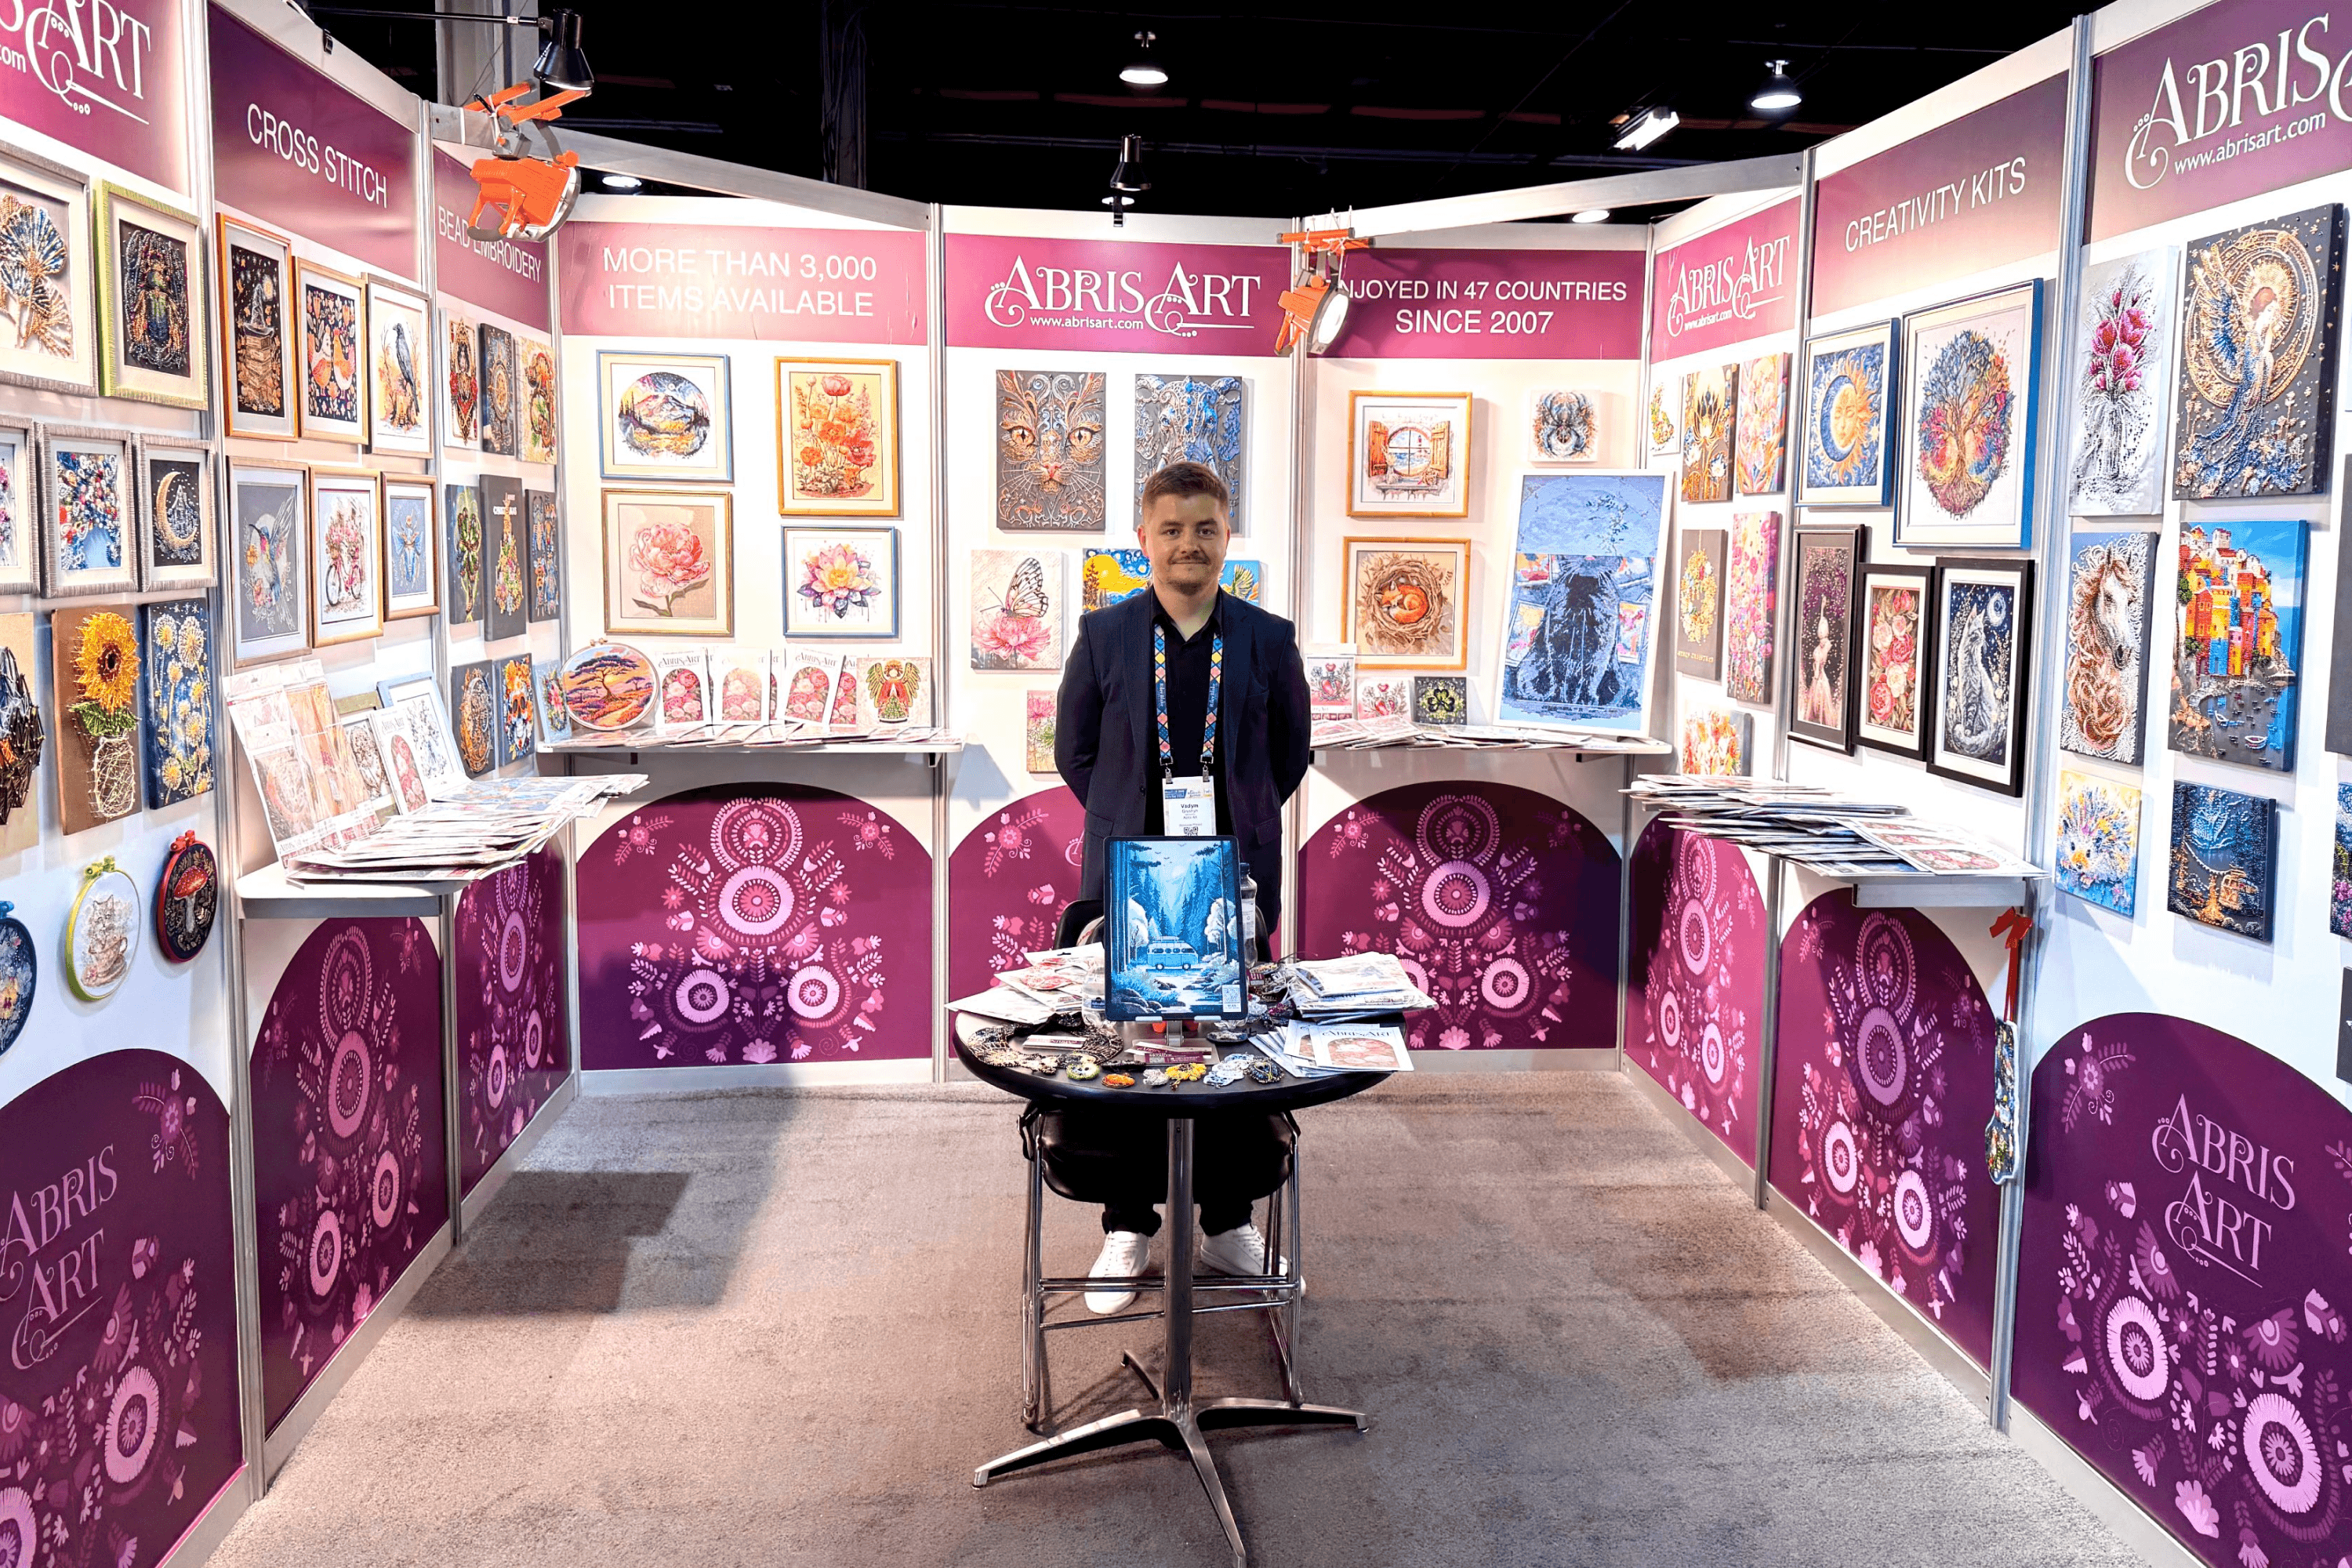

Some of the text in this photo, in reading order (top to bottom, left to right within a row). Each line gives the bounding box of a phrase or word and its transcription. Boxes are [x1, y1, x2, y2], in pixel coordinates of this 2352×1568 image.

[2125, 13, 2330, 189] ABRIS
[2175, 112, 2326, 174] www.abrisart.com
[248, 103, 387, 209] CROSS STITCH
[438, 205, 541, 283] BEAD EMBROIDERY
[1845, 157, 2026, 252] CREATIVITY KITS
[604, 247, 877, 281] MORE THAN 3,000
[609, 285, 873, 317] ITEMS AVAILABLE
[985, 255, 1261, 336] ABRIS ART
[1326, 279, 1628, 301] NJOYED IN 47 COUNTRIES
[1667, 235, 1790, 337] ABRIS ART
[1029, 315, 1144, 329] www.abrisart.com
[1396, 310, 1554, 334] SINCE 2007
[2152, 1094, 2296, 1210] ABRIS
[0, 1143, 118, 1301] ABRIS
[2165, 1171, 2272, 1275] ART
[12, 1228, 104, 1370] ART
